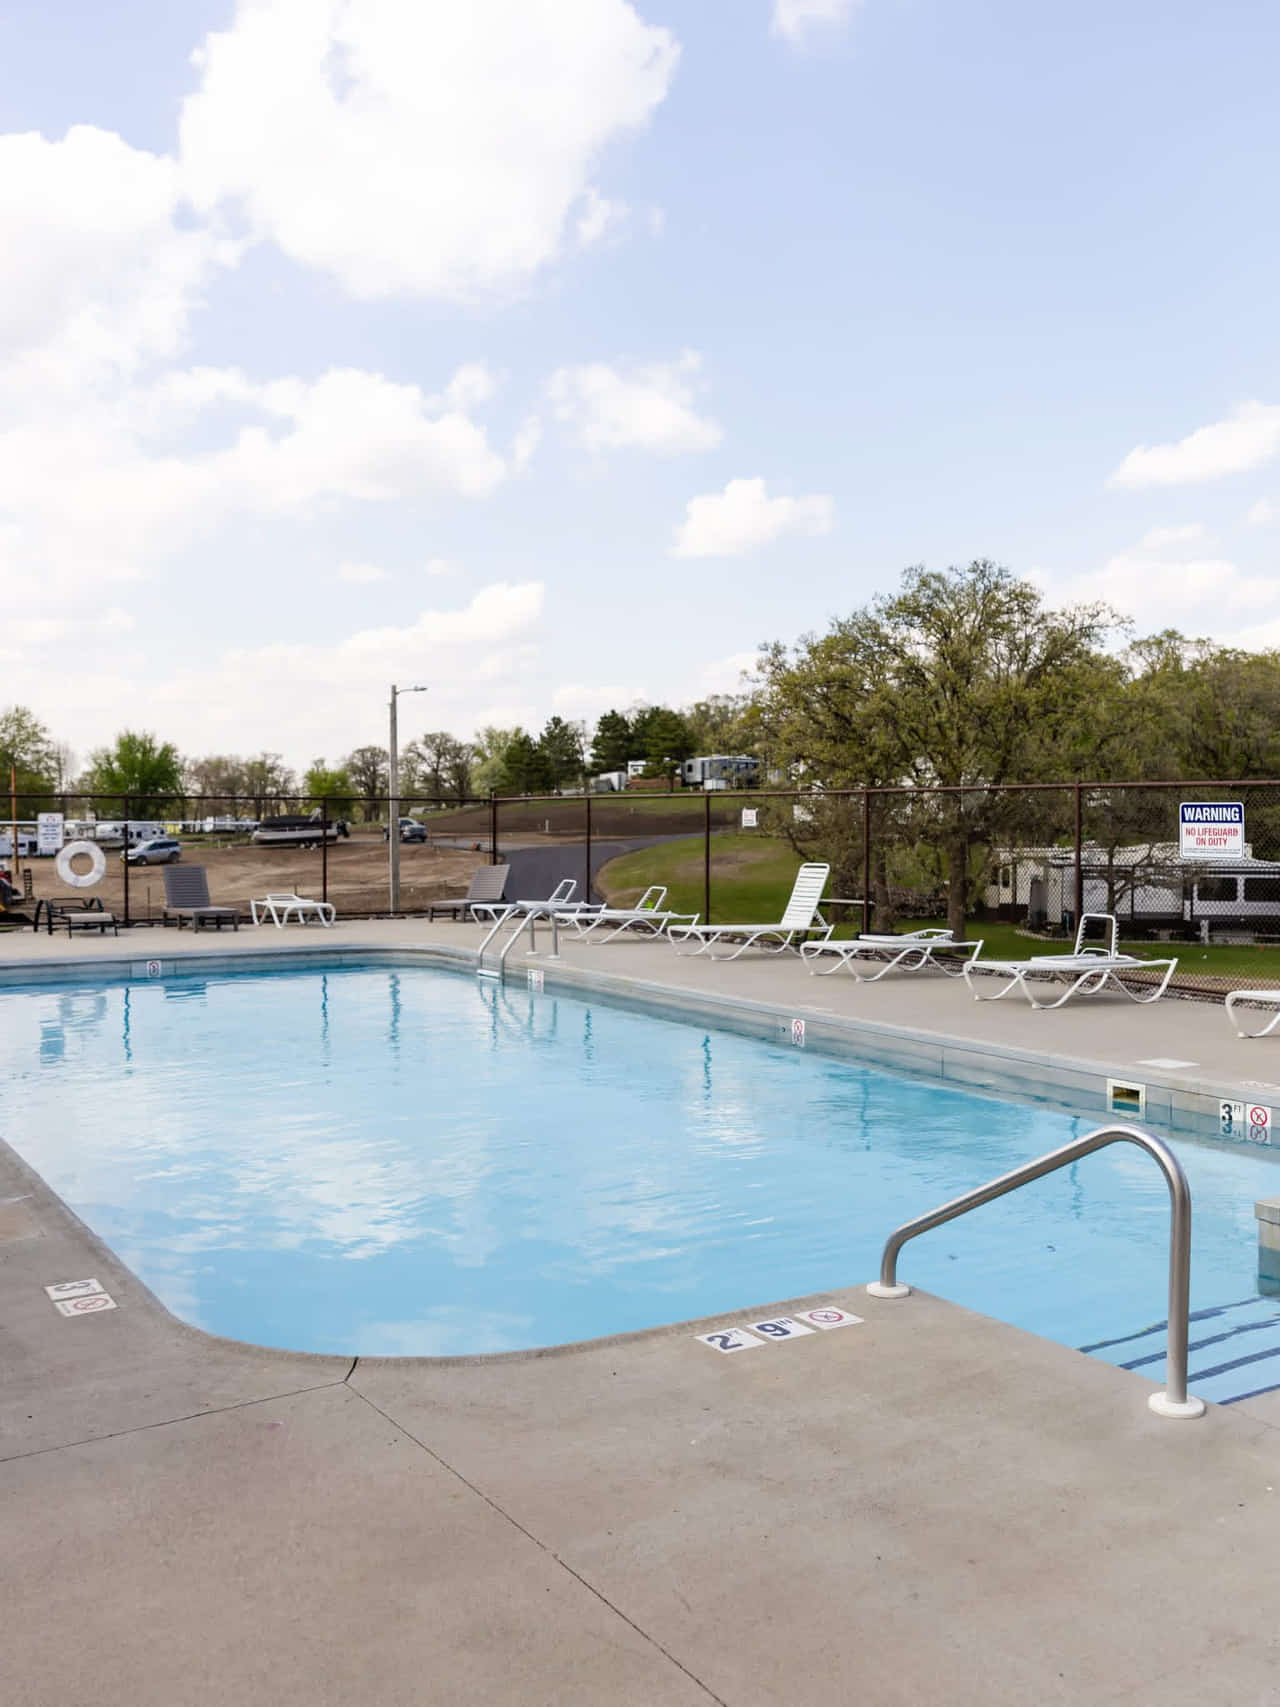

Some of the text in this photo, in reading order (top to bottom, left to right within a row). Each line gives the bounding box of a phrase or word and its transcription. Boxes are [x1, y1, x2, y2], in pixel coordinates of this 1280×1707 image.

[1184, 807, 1240, 821] WARNING
[1185, 828, 1239, 837] NO LIFEGUARD
[1196, 838, 1228, 846] ON DUTY
[1222, 1104, 1232, 1121] 3
[706, 1335, 743, 1350] 2
[756, 1323, 791, 1336] 9
